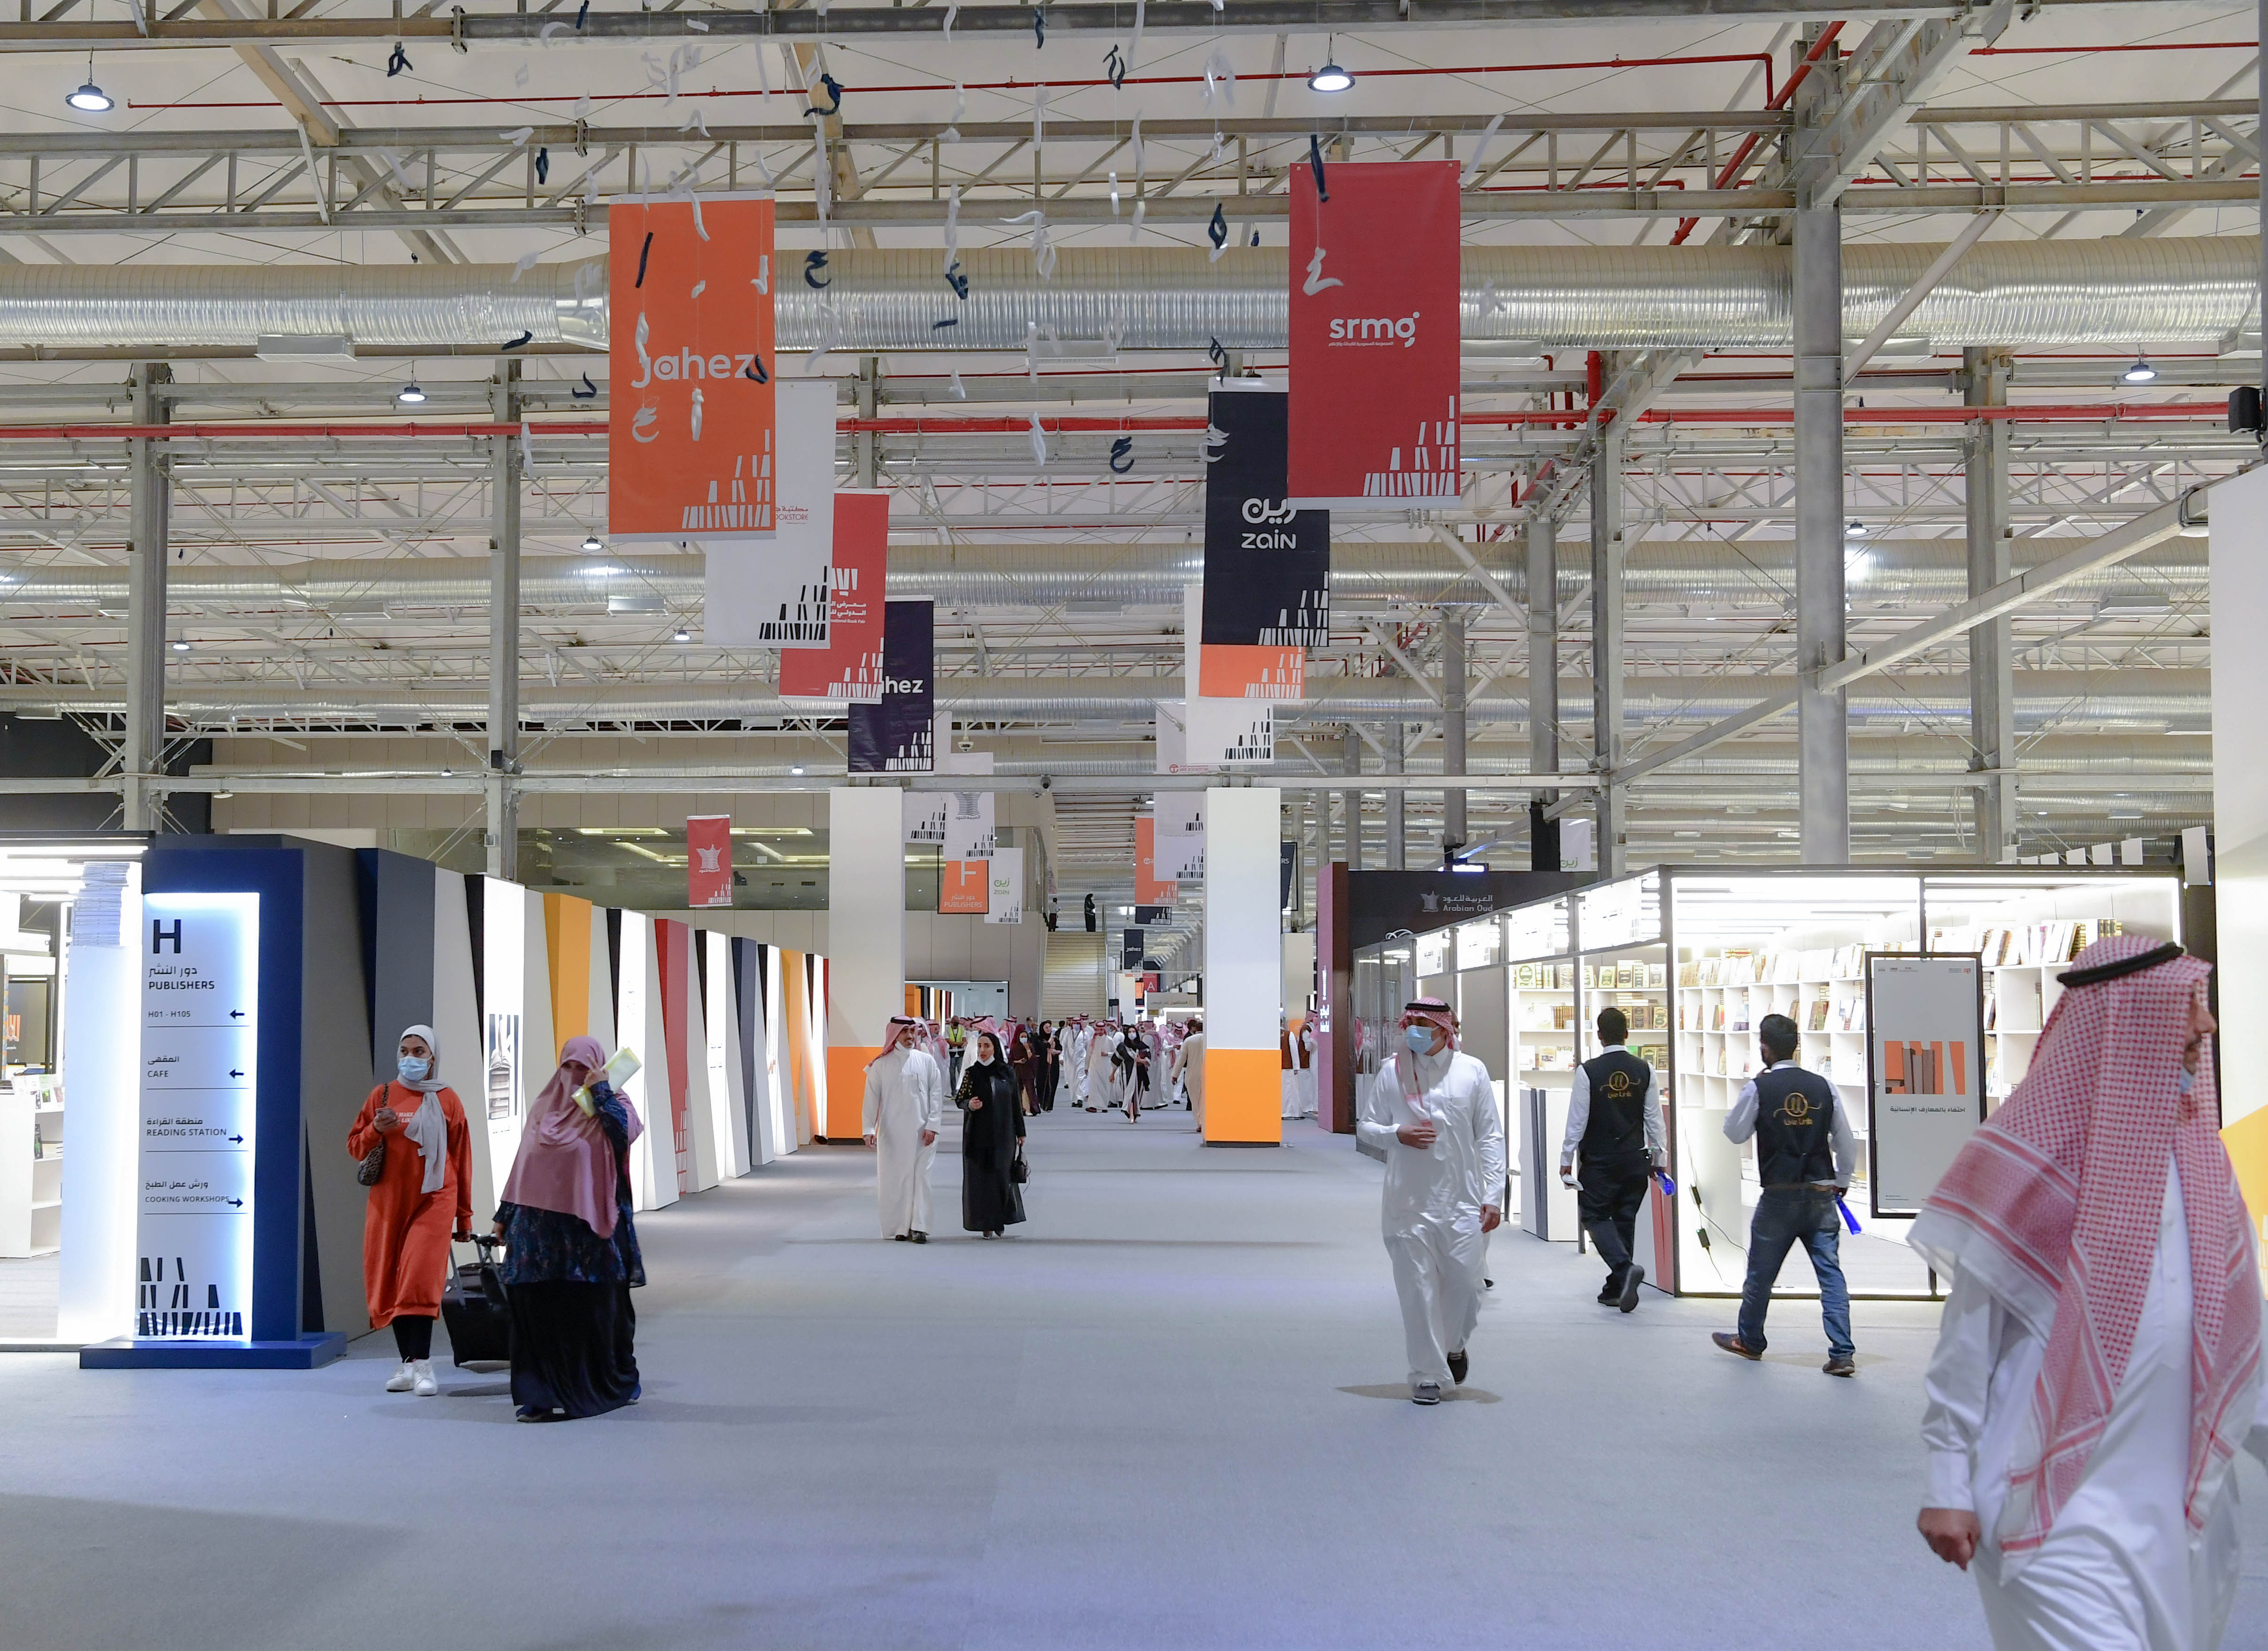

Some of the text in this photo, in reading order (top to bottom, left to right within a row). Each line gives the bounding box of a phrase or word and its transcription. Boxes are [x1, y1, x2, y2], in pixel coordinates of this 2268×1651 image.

[1329, 311, 1420, 348] srmg
[631, 347, 754, 388] jahez
[837, 609, 867, 618] الدولي
[883, 675, 924, 694] hez
[961, 859, 977, 886] F
[994, 878, 1010, 887] زين
[1443, 895, 1493, 903] العربية للعود
[153, 919, 181, 954] H
[148, 963, 198, 978] دور النشر
[149, 980, 215, 989] PUBLISHERS
[1147, 981, 1155, 991] A
[148, 1055, 180, 1065] المقهى
[147, 1118, 173, 1127] القراءة
[145, 1178, 208, 1190] ورش عمل الطبخ
